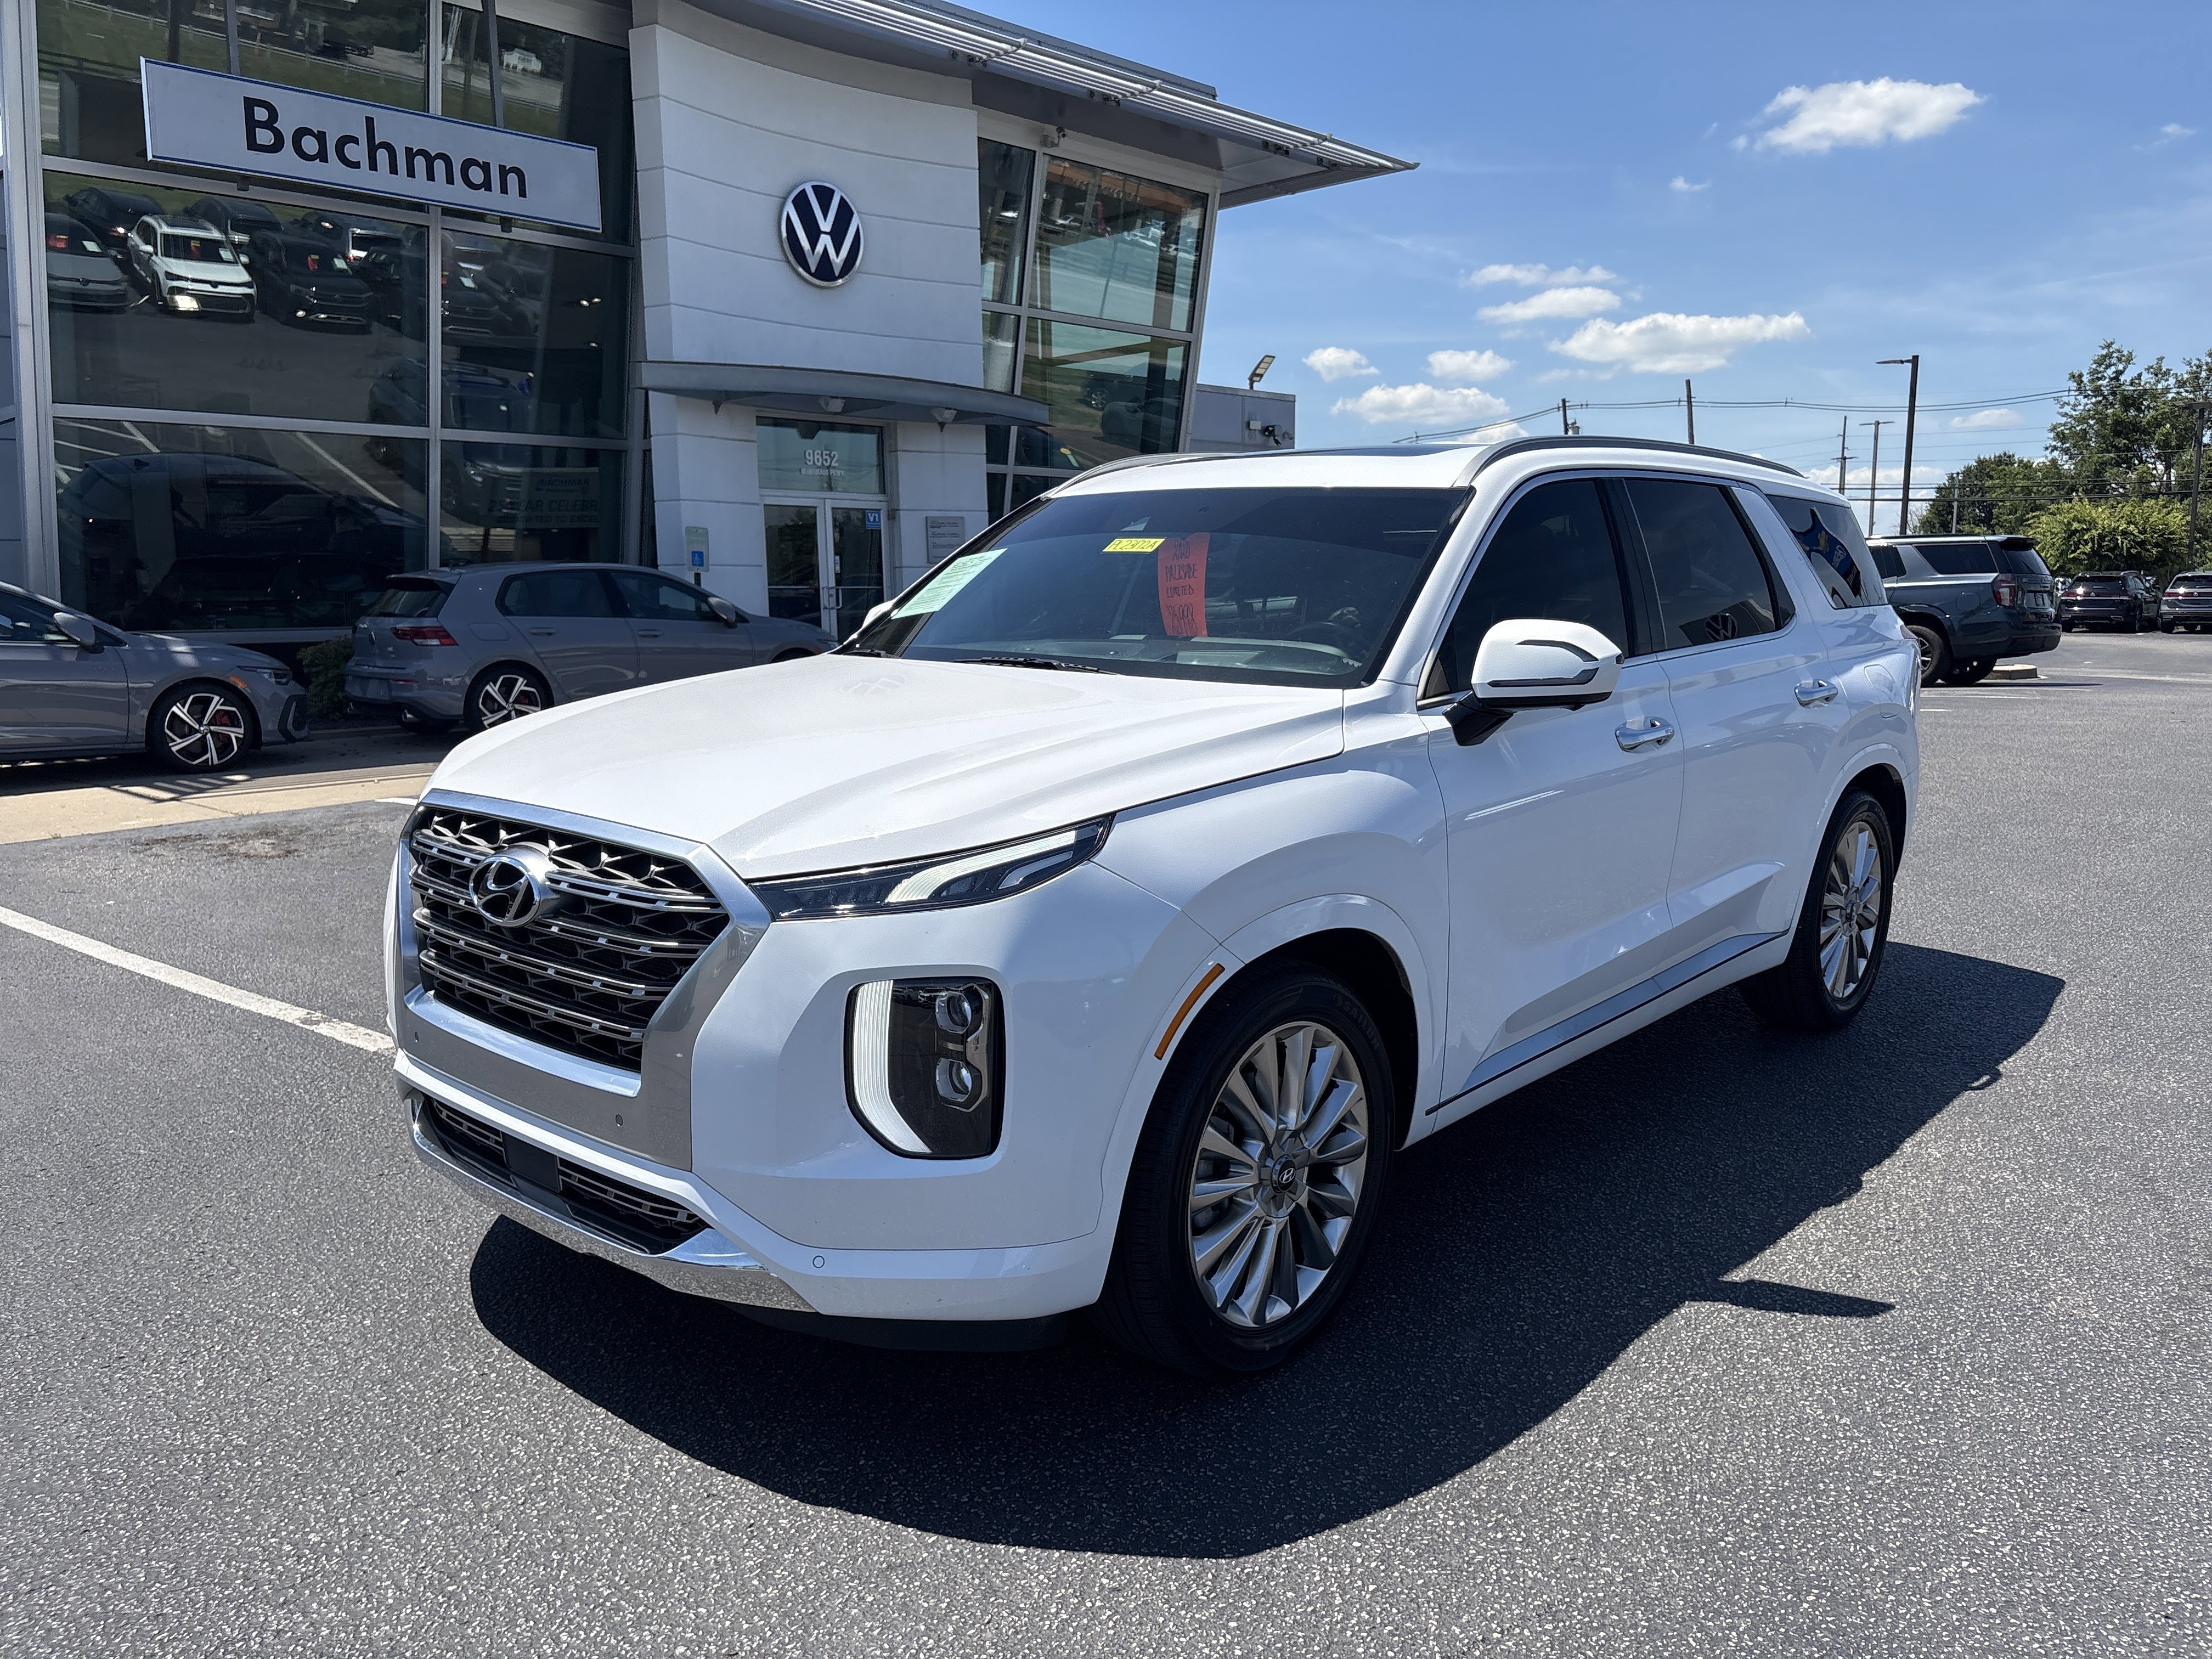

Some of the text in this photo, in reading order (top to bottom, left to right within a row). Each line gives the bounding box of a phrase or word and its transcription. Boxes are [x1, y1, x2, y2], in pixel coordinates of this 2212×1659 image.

[242, 96, 528, 199] Bachman
[783, 182, 862, 279] VW
[805, 449, 839, 466] 9652
[1343, 1001, 1379, 1050] SAILUN
